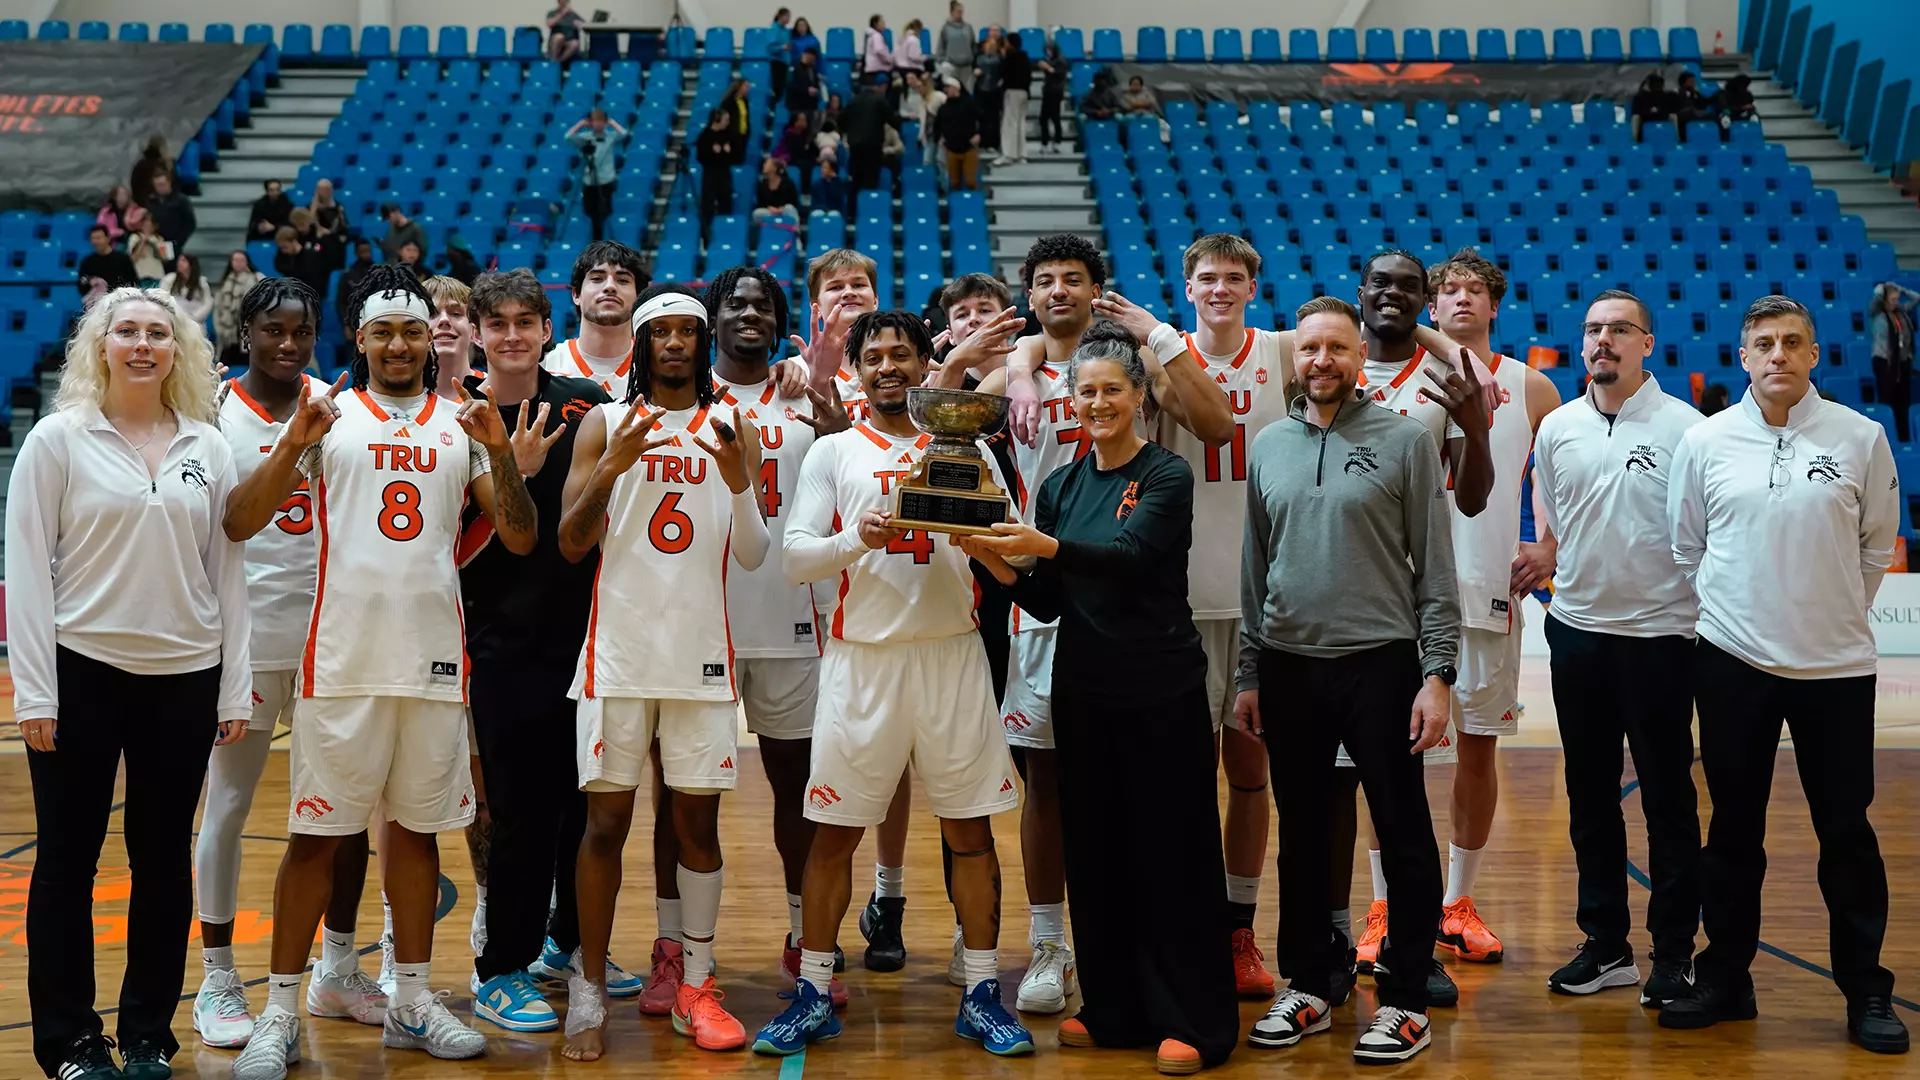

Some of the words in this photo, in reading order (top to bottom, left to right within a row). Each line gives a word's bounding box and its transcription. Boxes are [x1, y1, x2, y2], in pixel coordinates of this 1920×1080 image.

[368, 443, 437, 473] TRU
[641, 454, 707, 485] TRU
[1808, 460, 1840, 468] WOLFPACK
[377, 480, 423, 541] 8
[648, 491, 694, 554] 6
